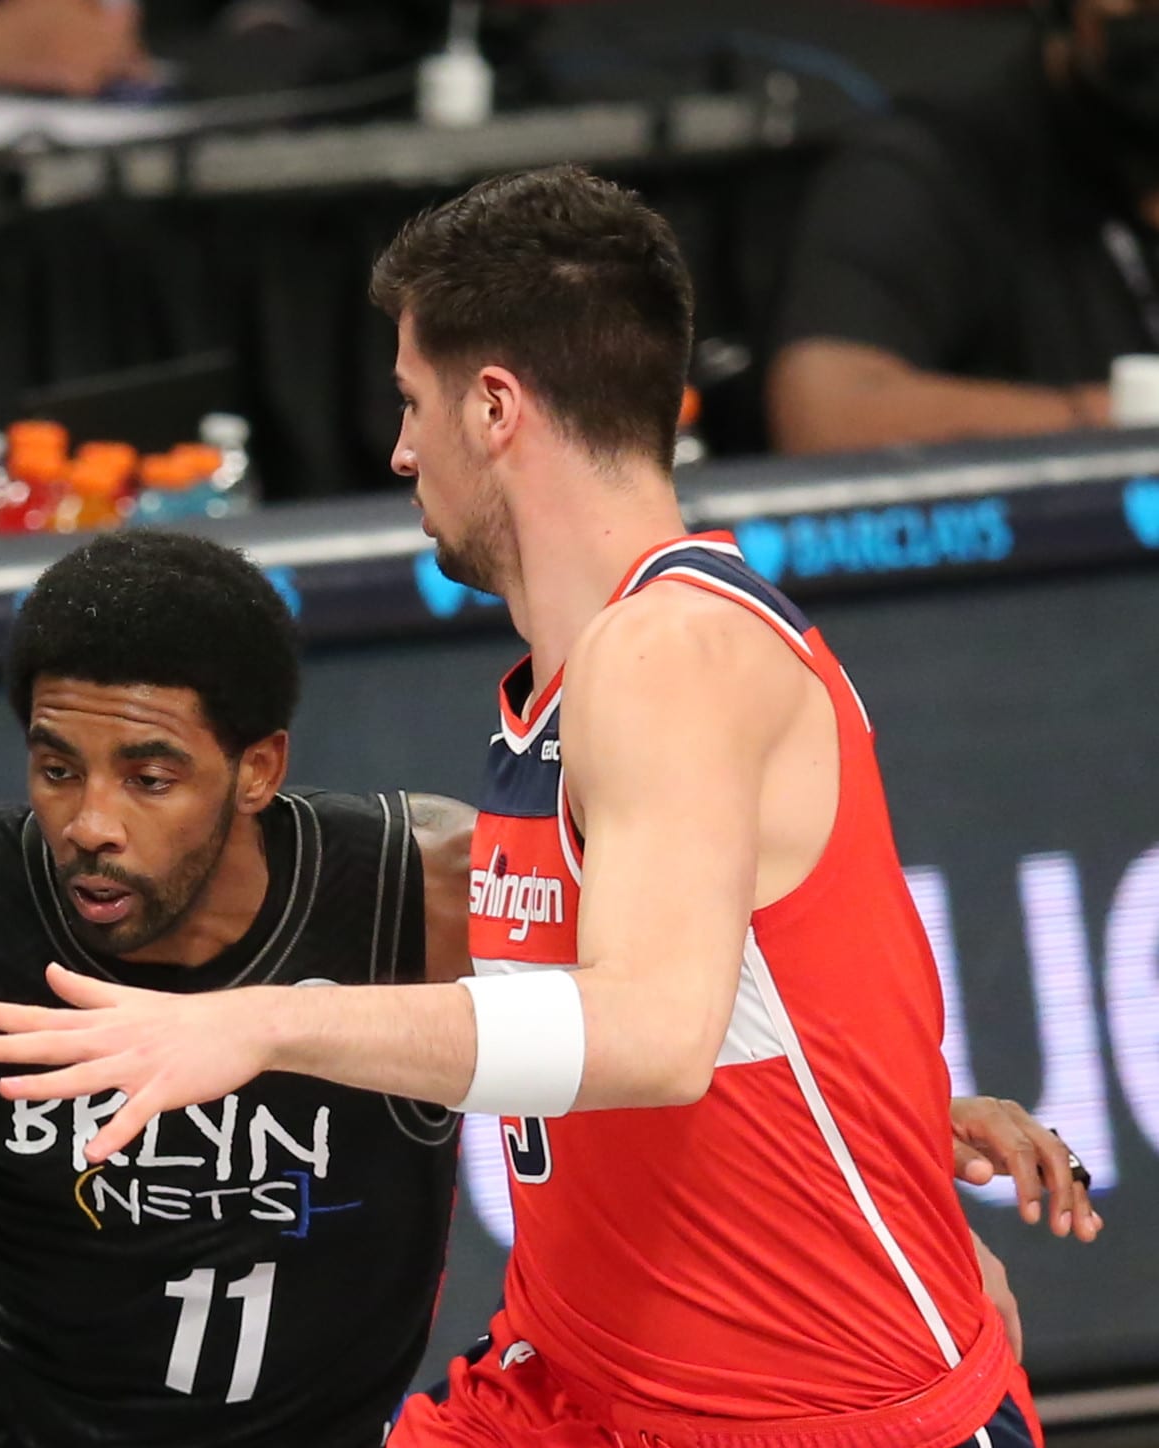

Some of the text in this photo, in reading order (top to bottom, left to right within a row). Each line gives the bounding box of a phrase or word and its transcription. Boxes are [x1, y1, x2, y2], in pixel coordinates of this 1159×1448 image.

[787, 496, 1014, 579] BARCLAYS
[469, 843, 564, 942] shington
[164, 1261, 277, 1404] 11
